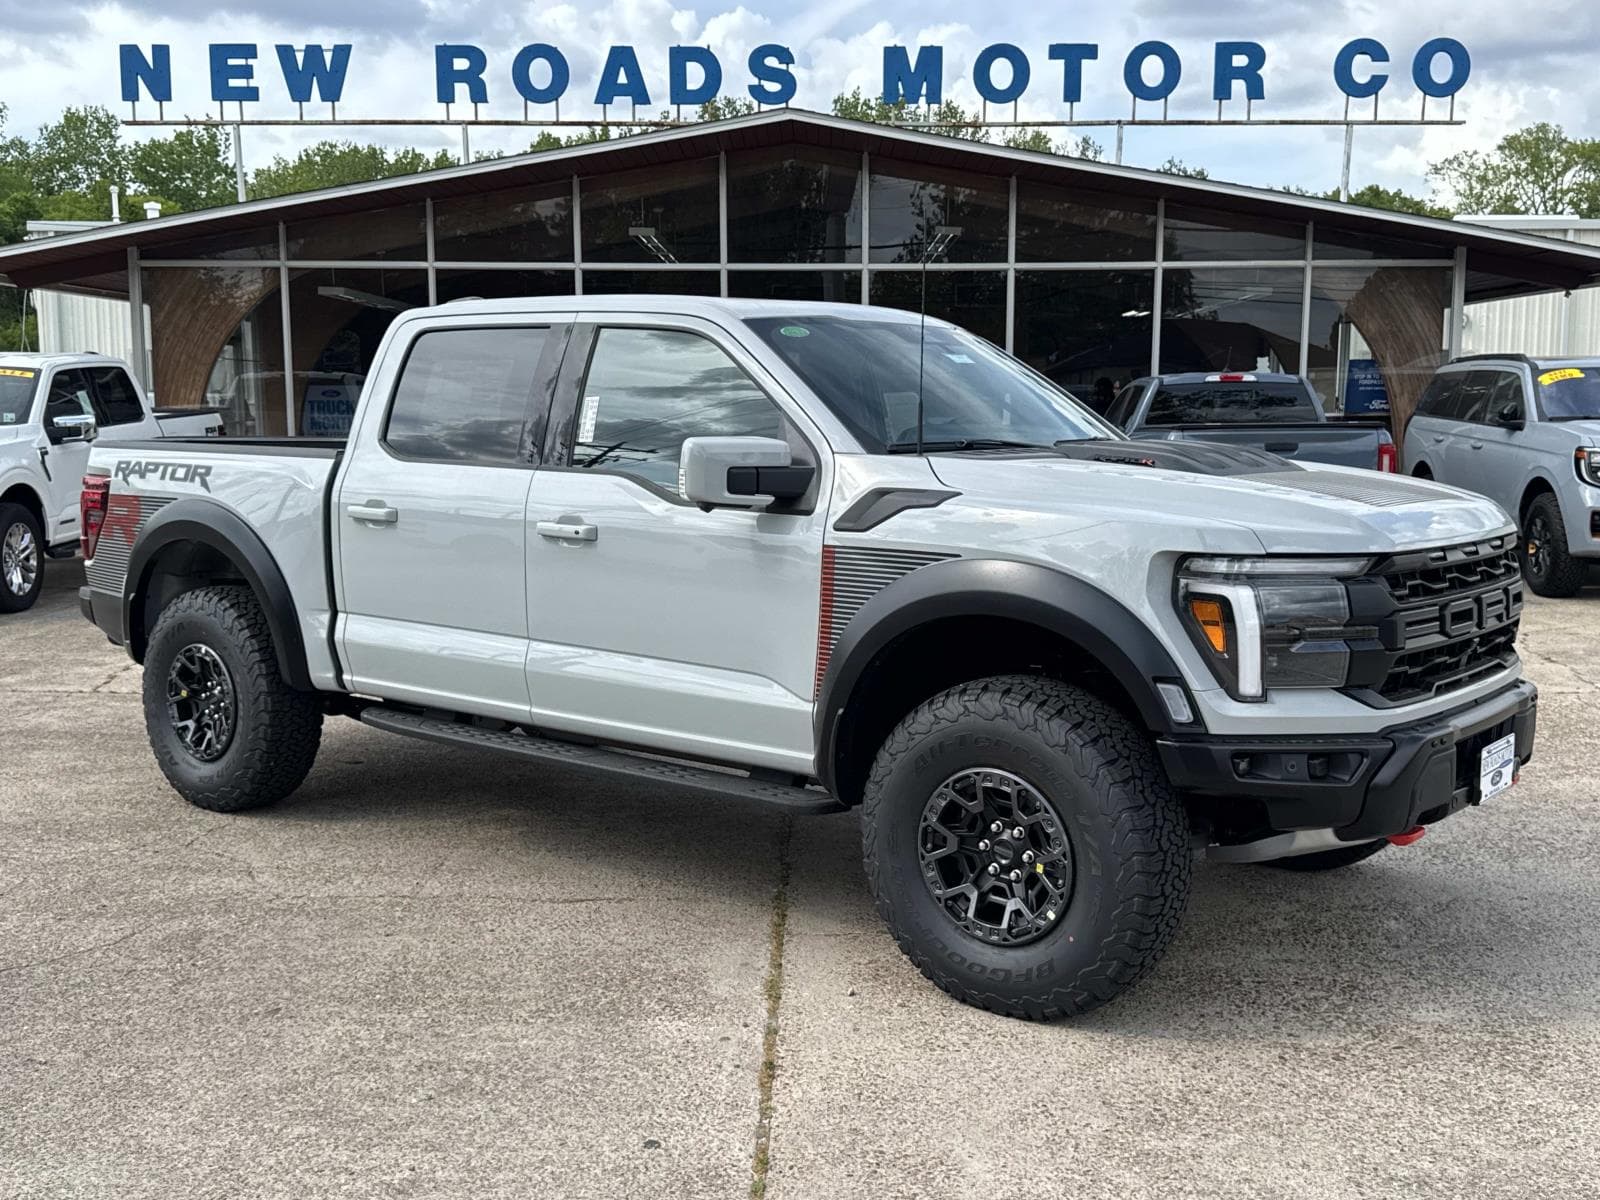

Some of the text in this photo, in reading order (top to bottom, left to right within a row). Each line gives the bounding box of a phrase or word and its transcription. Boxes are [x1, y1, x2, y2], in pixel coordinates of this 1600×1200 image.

[119, 38, 1471, 105] NEW ROADS MOTOR CO
[114, 460, 213, 494] RAPTOR
[1397, 580, 1523, 648] FORD
